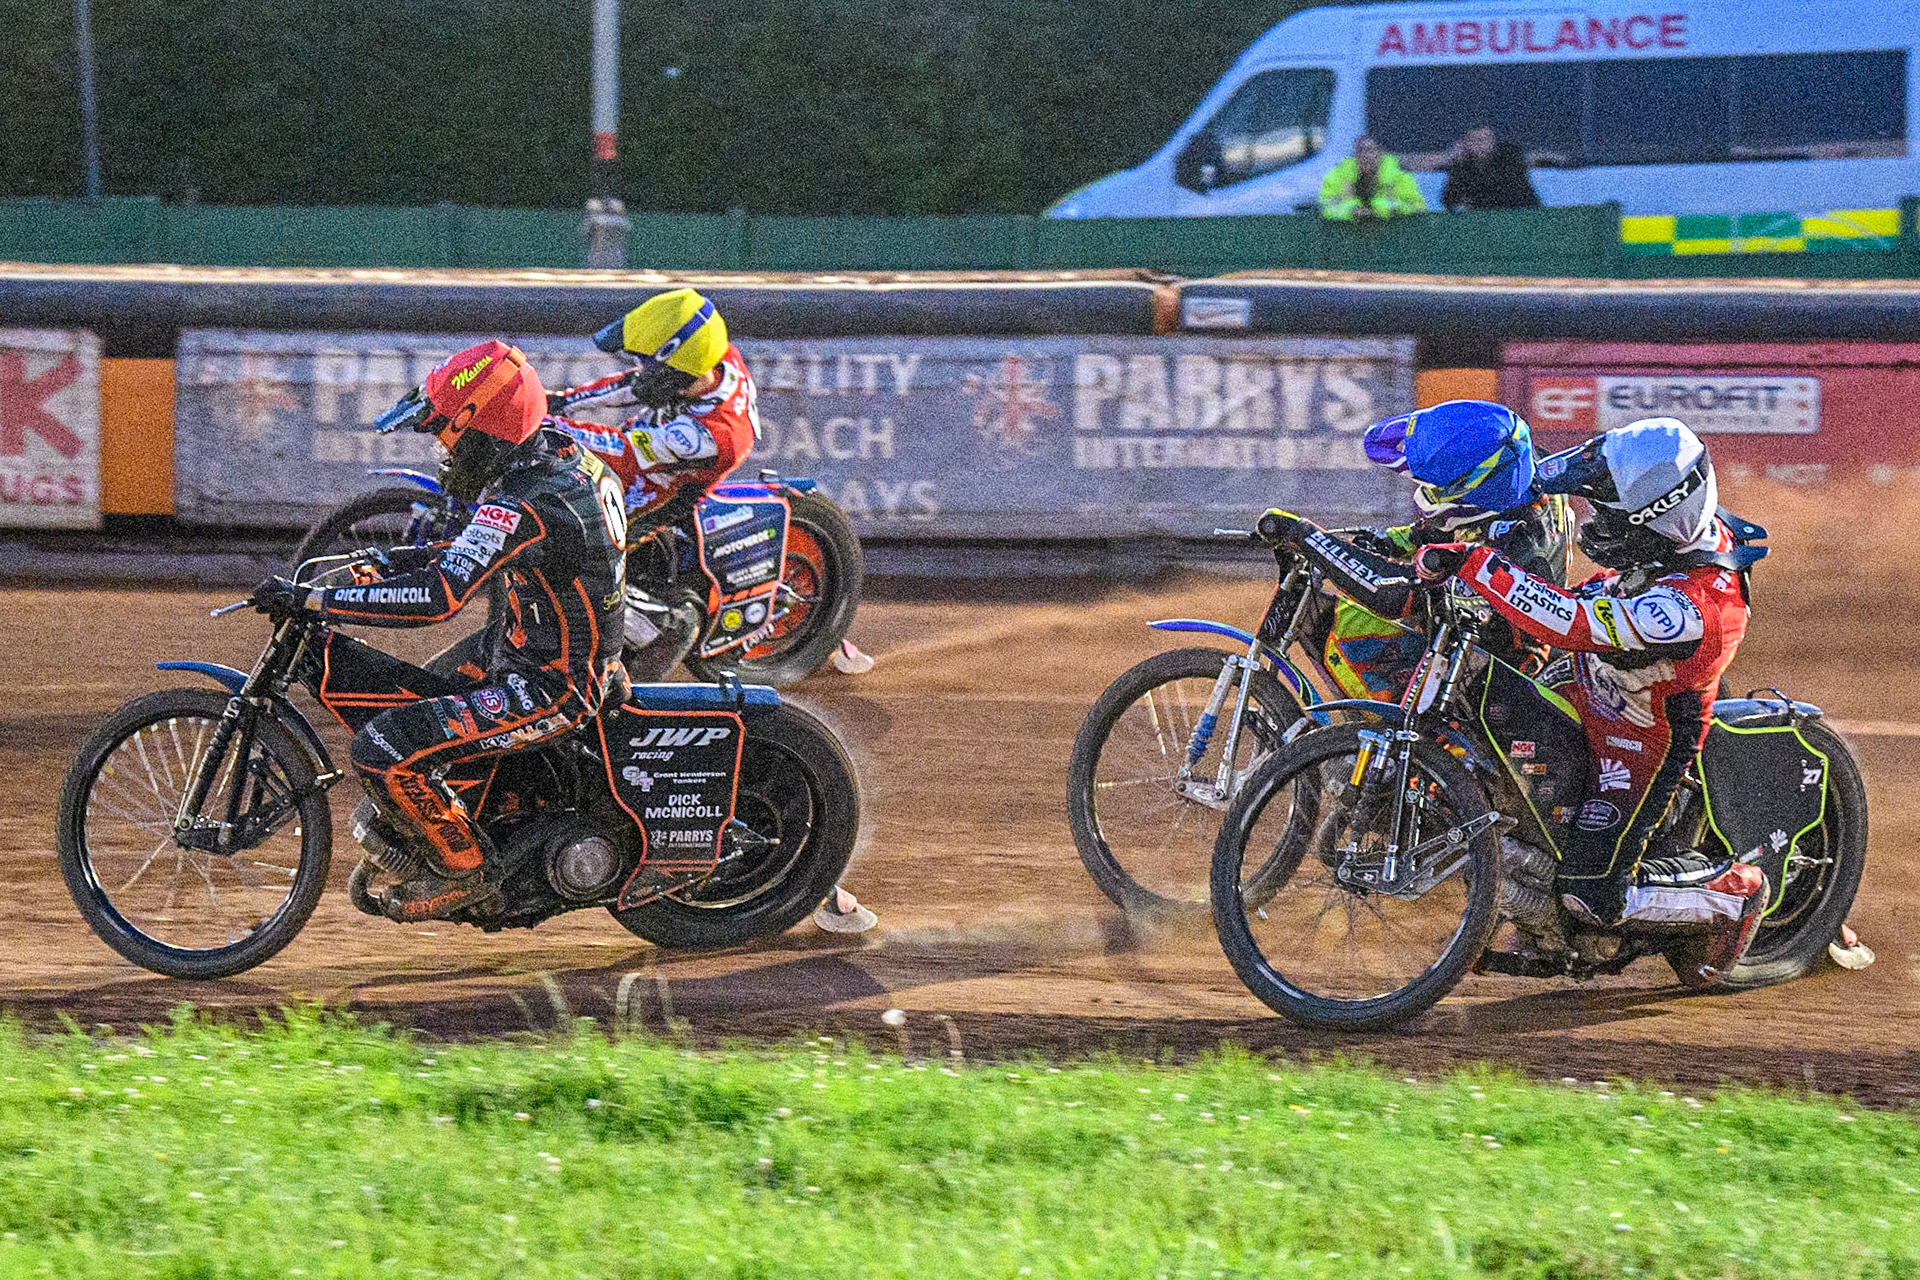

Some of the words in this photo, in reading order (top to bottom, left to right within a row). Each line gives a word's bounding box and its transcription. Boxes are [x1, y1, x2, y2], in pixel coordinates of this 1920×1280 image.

[1377, 14, 1688, 56] AMBULANCE
[1074, 354, 1375, 430] PARRYS
[1608, 385, 1784, 411] EUROFIT
[757, 417, 894, 459] OACH
[1629, 481, 1690, 525] OAKLEY
[477, 506, 517, 526] NGK
[440, 560, 471, 582] SKIPS
[335, 588, 364, 603] DICK
[368, 587, 432, 603] MCNICOLL
[1509, 594, 1532, 613] LTD
[1516, 584, 1573, 621] PLASTICS
[1644, 601, 1676, 633] ATPI
[629, 728, 731, 747] JWP
[1512, 742, 1535, 752] NGK
[631, 749, 674, 762] racing
[1802, 768, 1822, 784] 27
[668, 794, 701, 806] DICK
[645, 806, 723, 819] MCNICOLL
[669, 830, 714, 842] PARRYS
